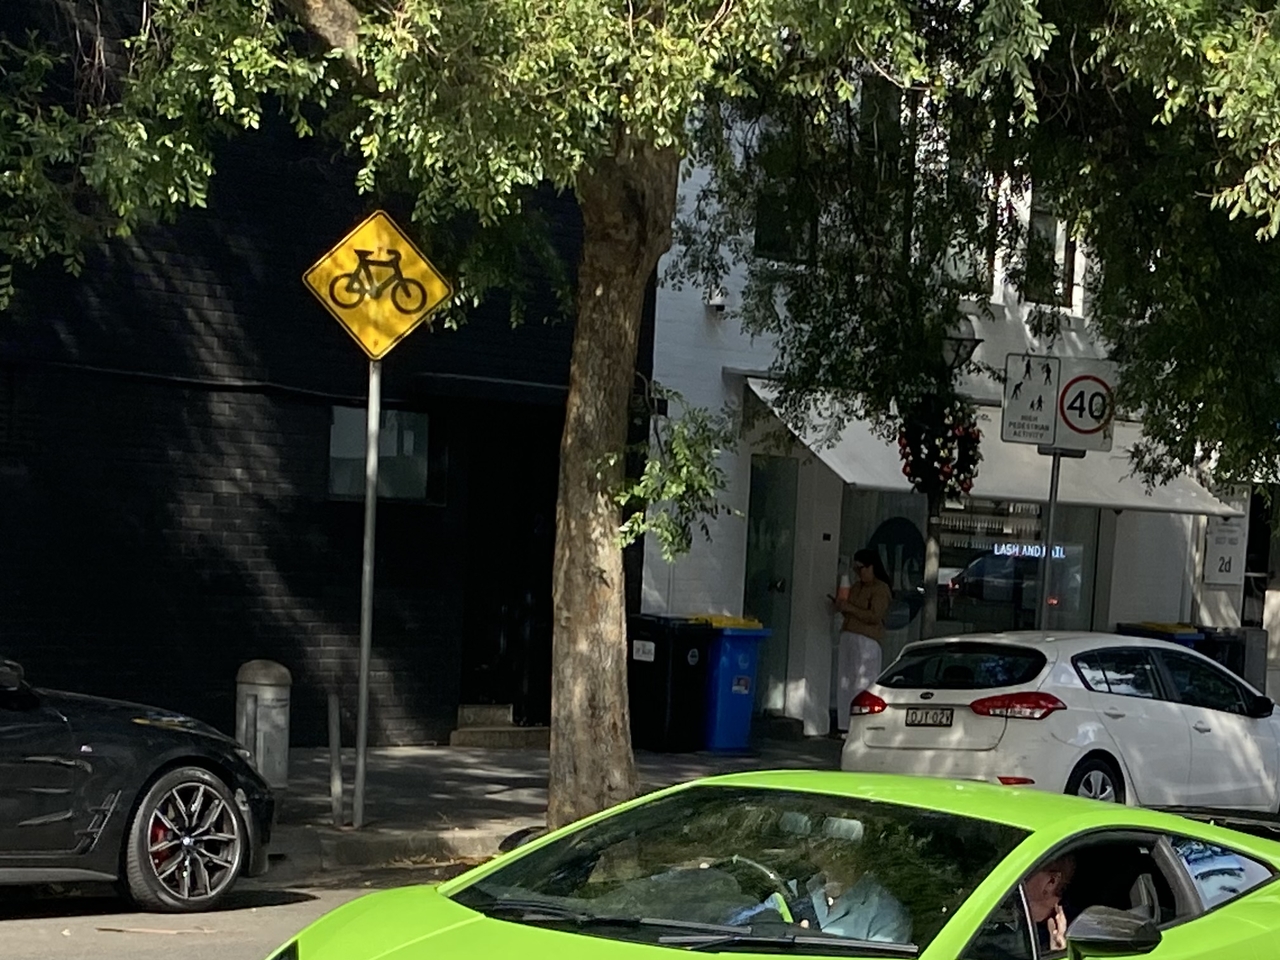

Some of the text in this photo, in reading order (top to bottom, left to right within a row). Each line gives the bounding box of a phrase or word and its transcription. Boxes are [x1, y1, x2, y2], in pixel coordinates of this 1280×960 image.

[1066, 390, 1107, 420] 40
[1008, 421, 1050, 432] PEDESTRIAN
[1013, 430, 1045, 439] ACTIVITY
[994, 543, 1019, 556] LASH
[1021, 545, 1040, 557] AND
[1218, 556, 1232, 573] 2d
